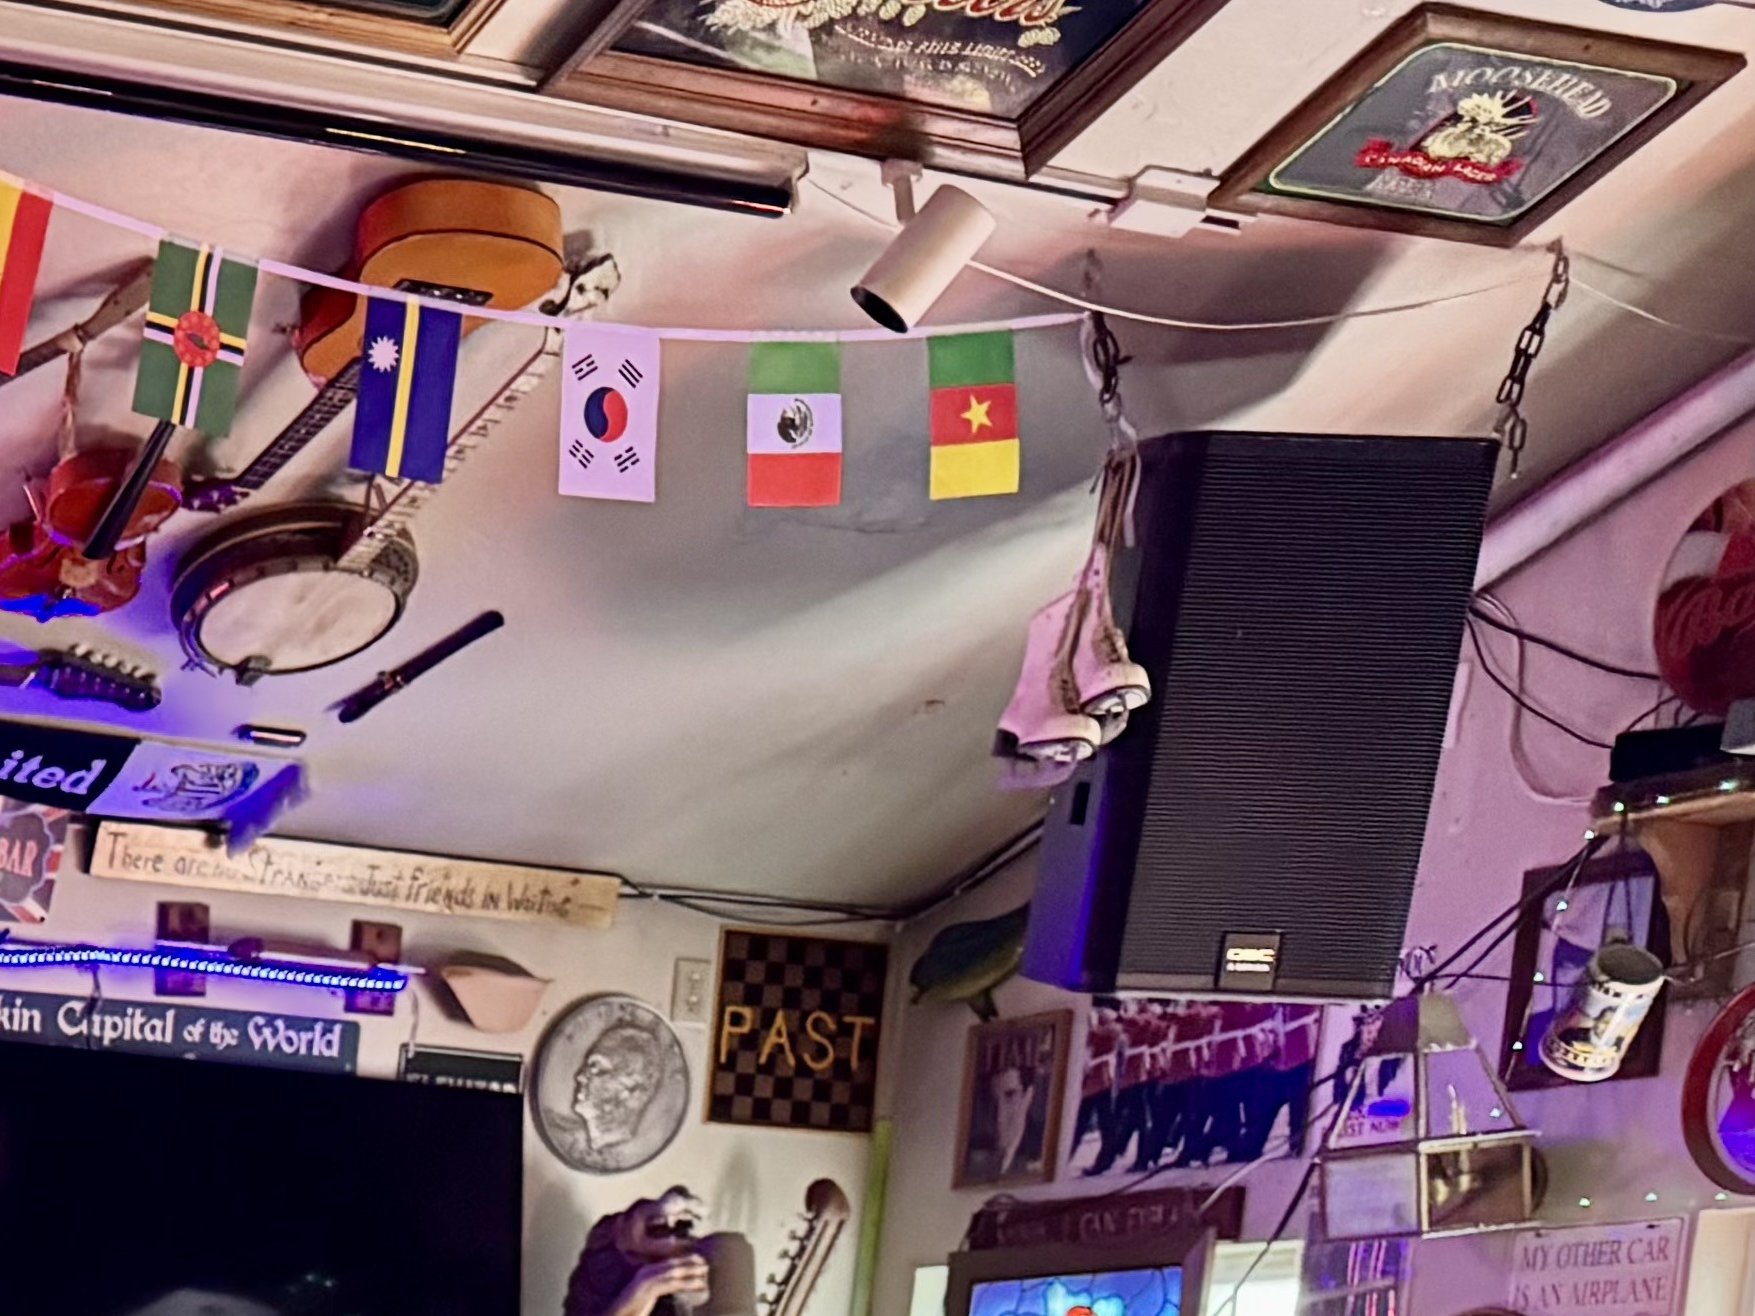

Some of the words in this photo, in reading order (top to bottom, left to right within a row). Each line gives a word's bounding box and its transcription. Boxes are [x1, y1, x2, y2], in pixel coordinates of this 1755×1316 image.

[1428, 65, 1612, 120] MOOSEHEAD
[106, 831, 164, 876] There
[182, 1017, 207, 1041] of
[208, 1020, 241, 1051] the
[247, 1014, 343, 1058] World
[719, 1004, 876, 1073] PAST
[1521, 1245, 1551, 1272] MY
[1555, 1239, 1624, 1270] OTHER
[1626, 1236, 1671, 1266] CAR
[1512, 1283, 1530, 1312] IS
[1540, 1282, 1564, 1309] AN
[1571, 1276, 1667, 1307] AIRPLANE
